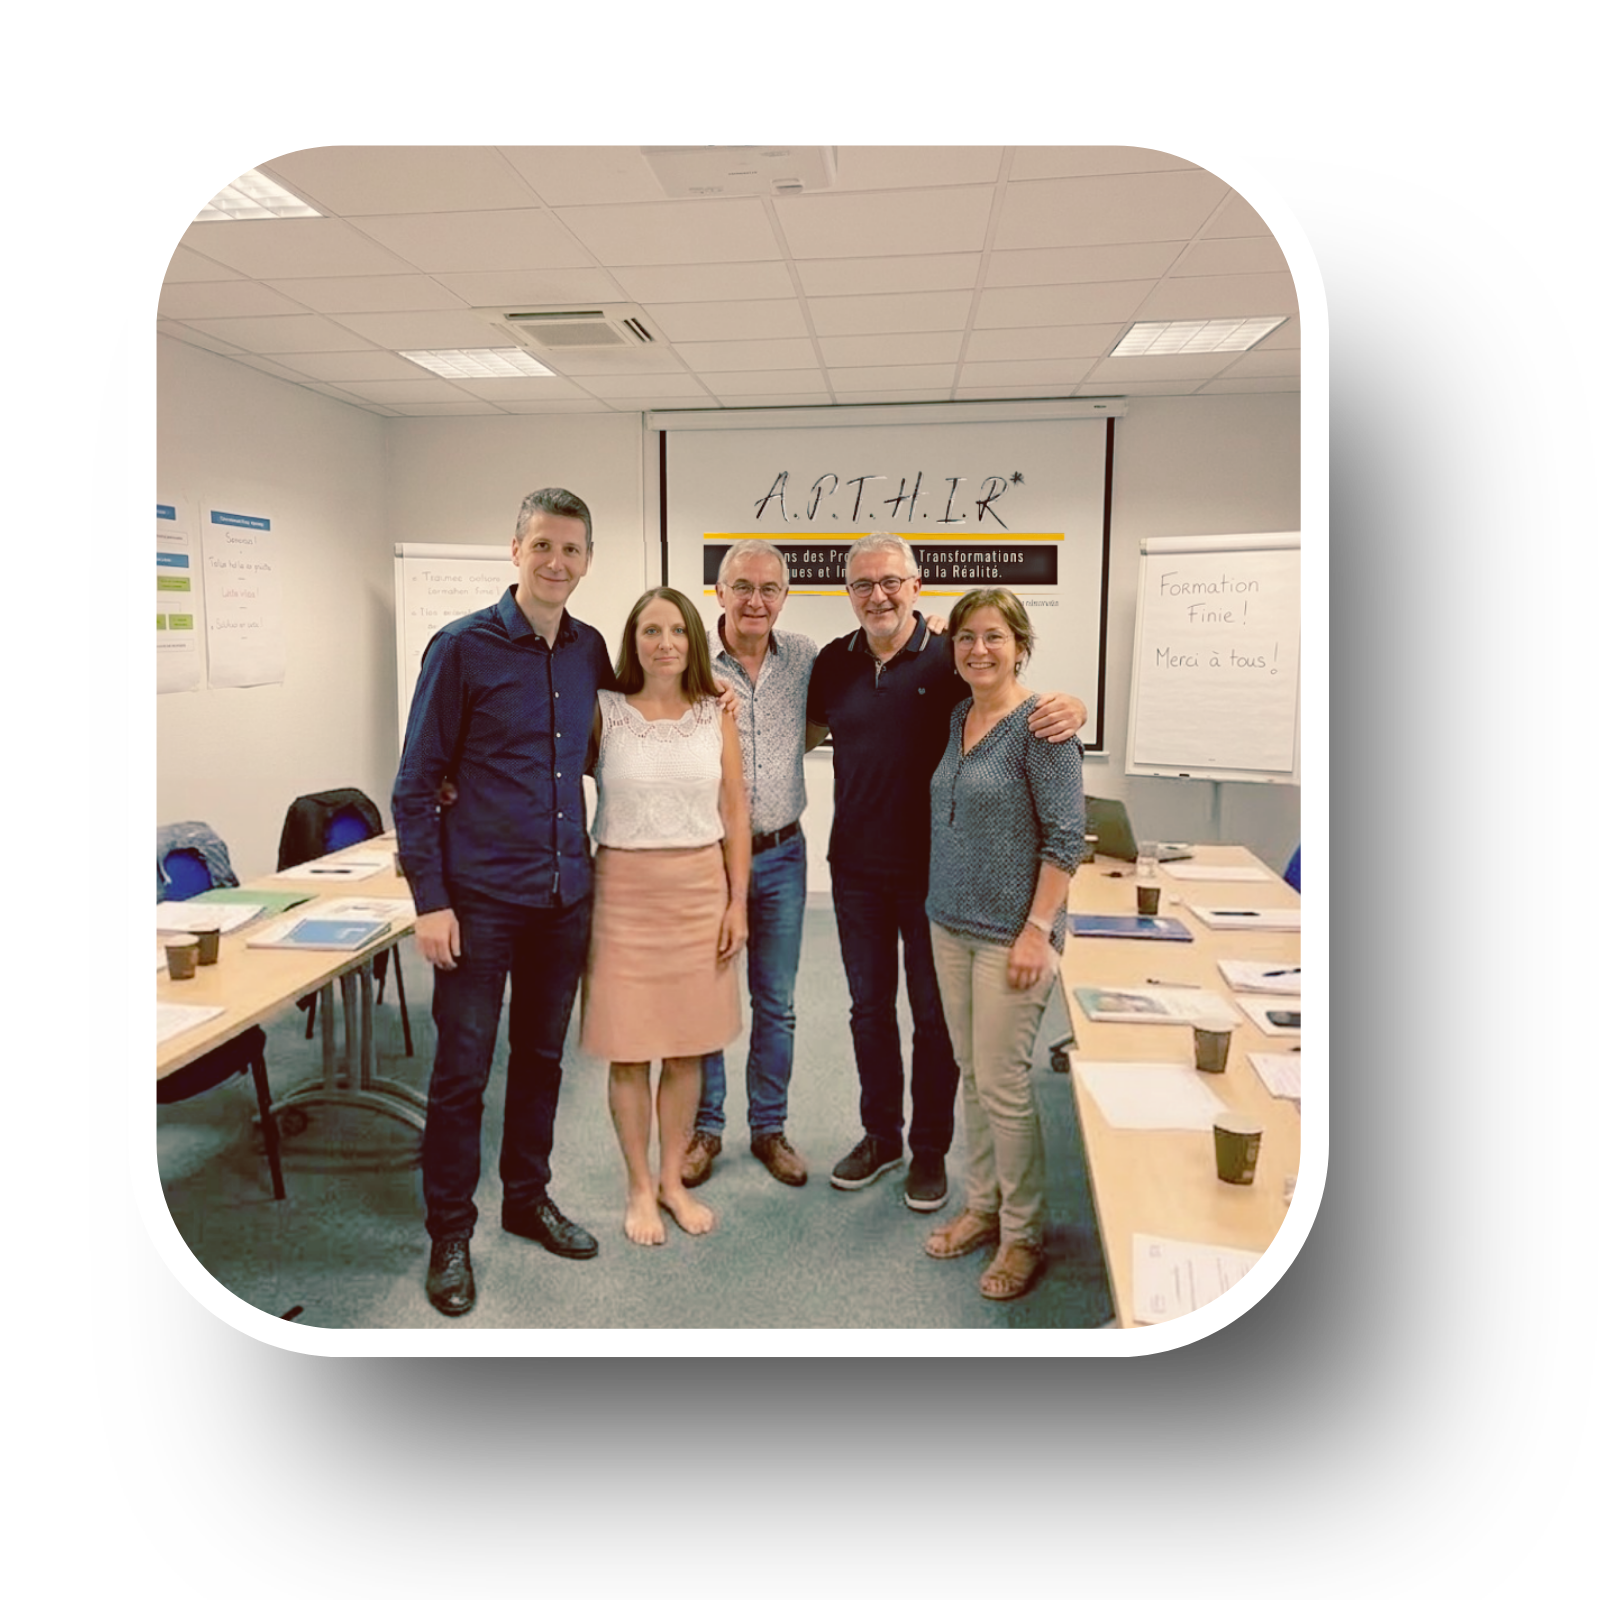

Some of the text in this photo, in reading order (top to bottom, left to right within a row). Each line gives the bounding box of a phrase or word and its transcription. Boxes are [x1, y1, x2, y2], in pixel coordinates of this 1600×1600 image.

[784, 549, 1024, 563] ns des Pro Transformations
[818, 566, 830, 579] et
[936, 565, 947, 578] la
[952, 564, 1002, 579] Réalité.
[1187, 602, 1236, 624] Finie
[1156, 646, 1199, 669] Merci
[1208, 650, 1221, 668] à
